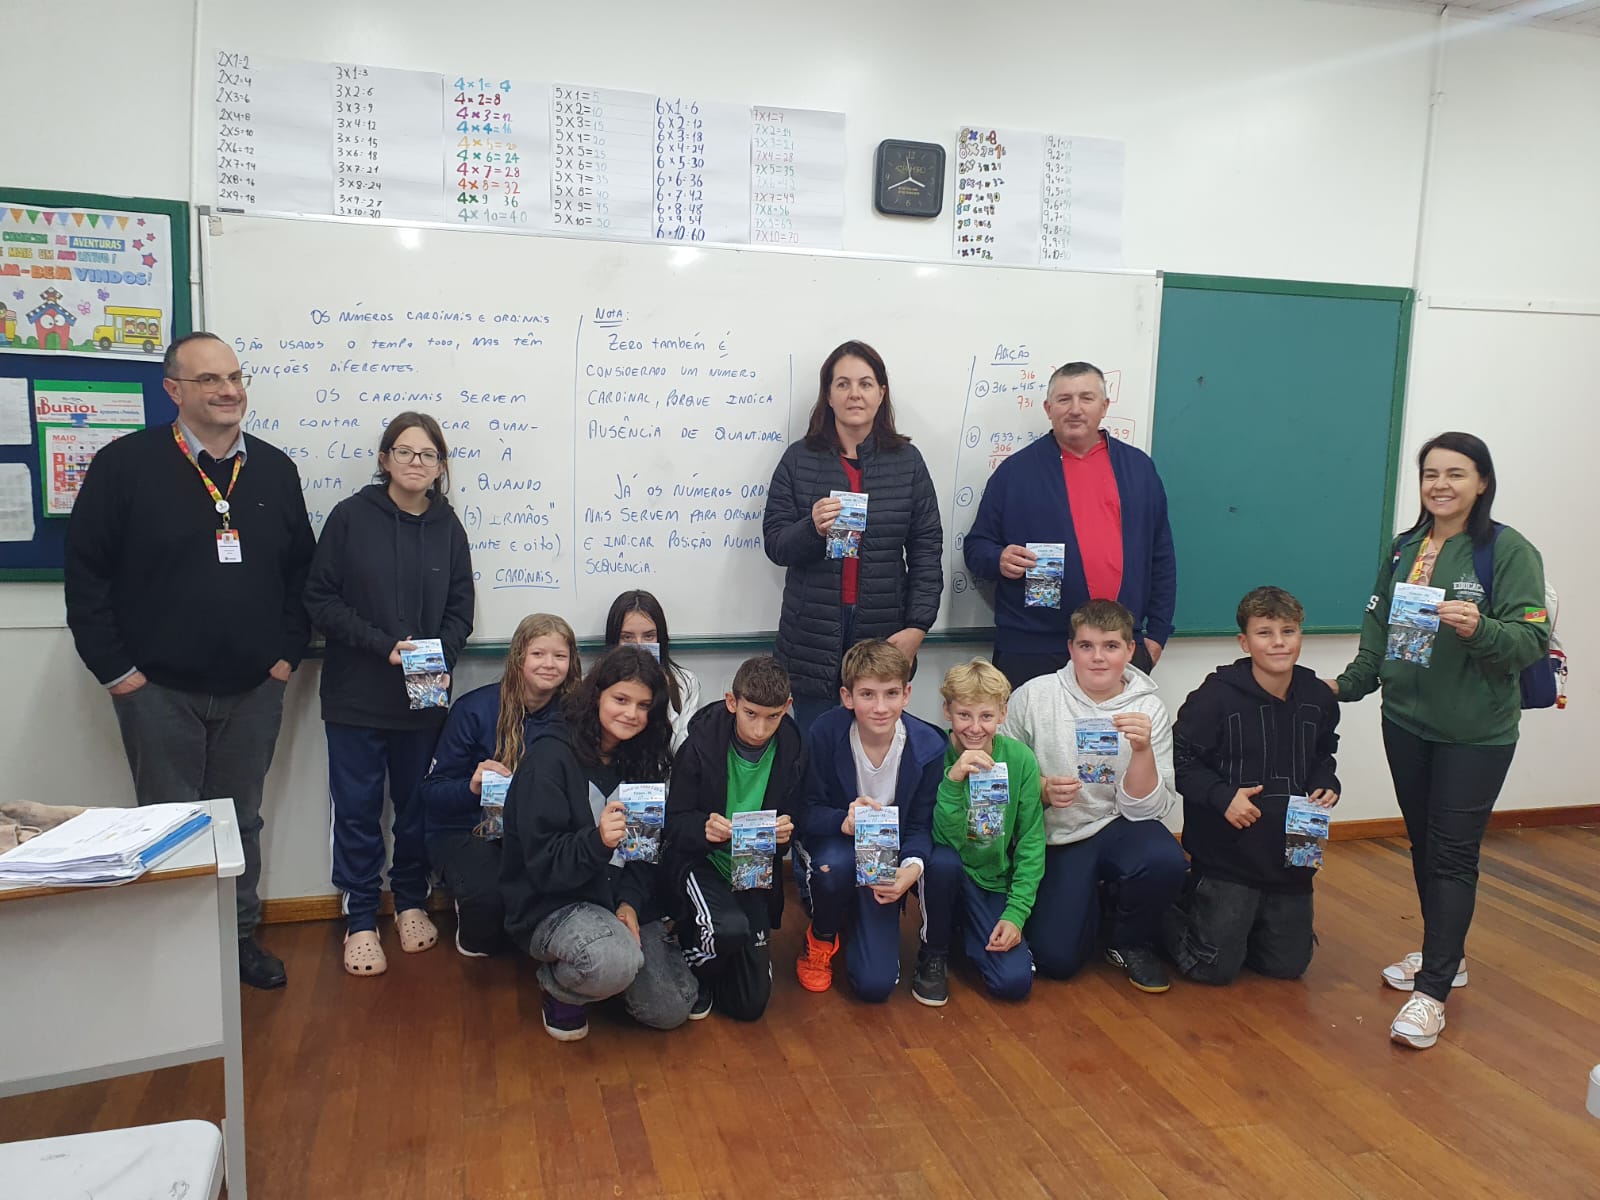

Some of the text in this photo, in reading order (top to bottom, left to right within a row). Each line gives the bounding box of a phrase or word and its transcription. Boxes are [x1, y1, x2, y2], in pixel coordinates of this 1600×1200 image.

[73, 237, 122, 250] AVENTURAS
[460, 389, 526, 404] SERVEM
[681, 429, 699, 439] DE
[478, 472, 541, 491] QUANDO
[620, 508, 679, 522] SERVEM
